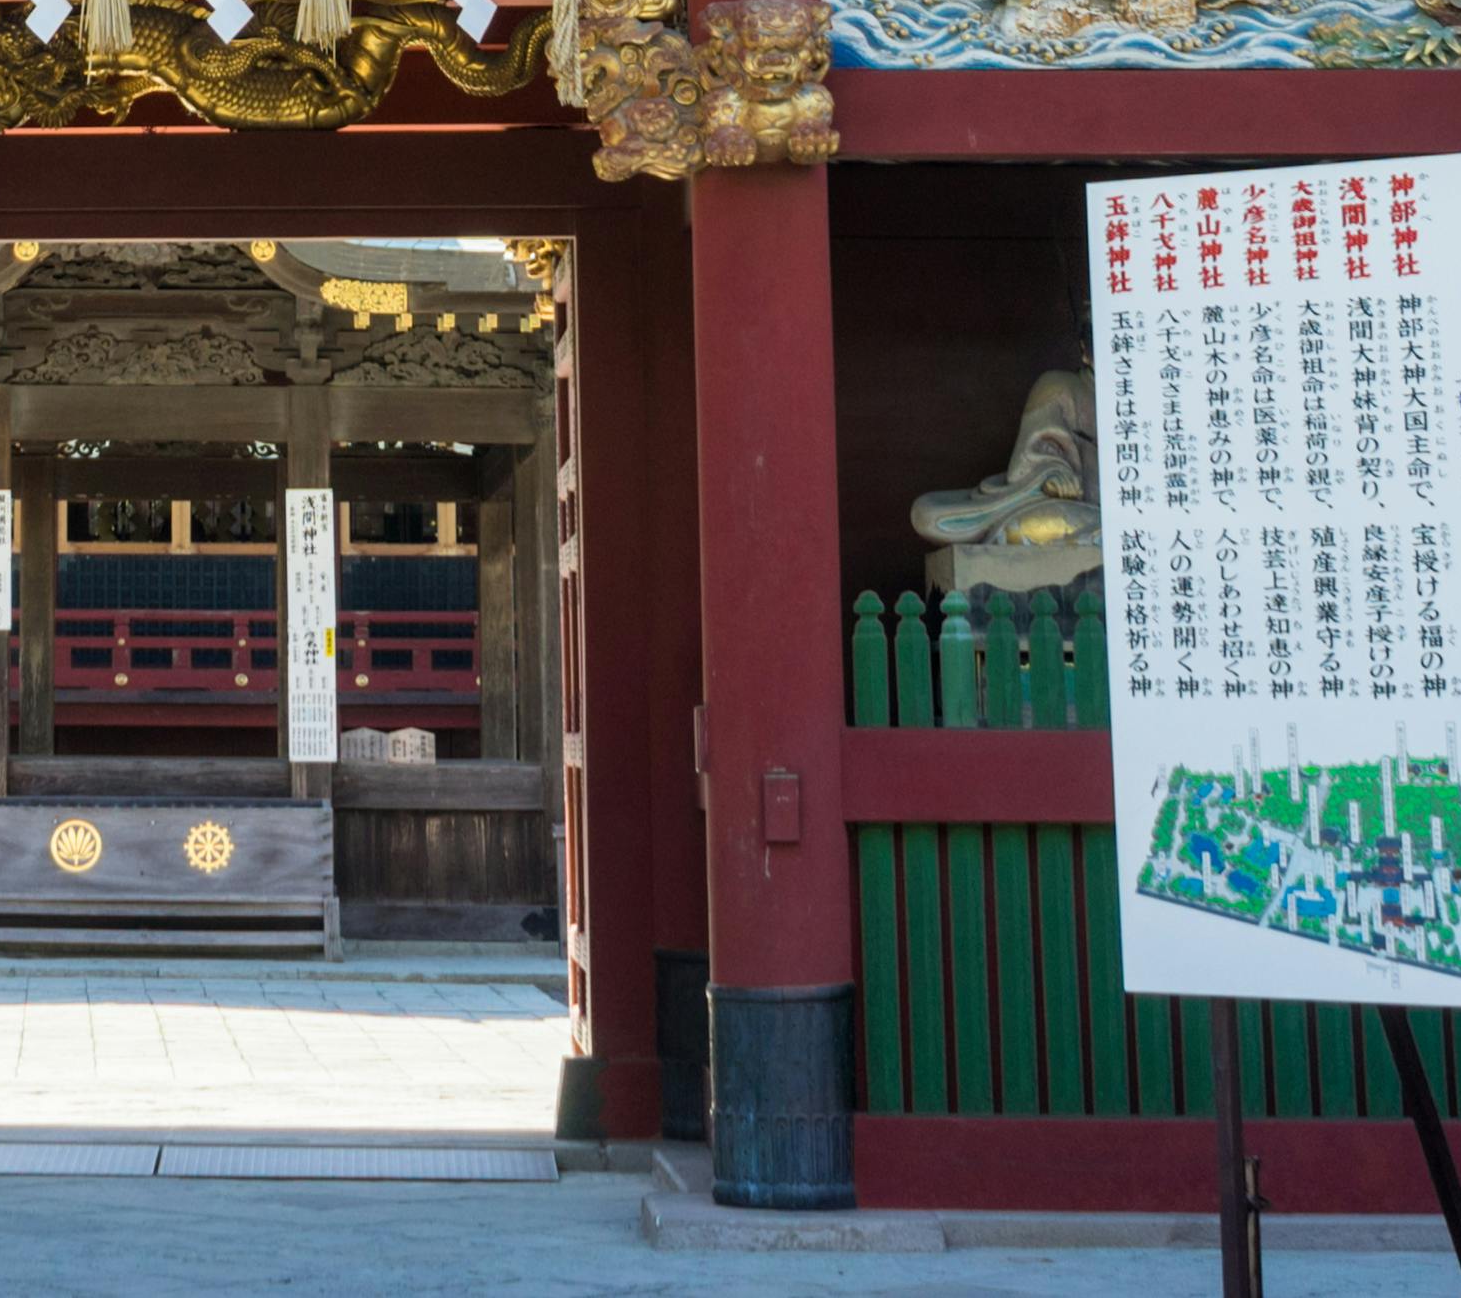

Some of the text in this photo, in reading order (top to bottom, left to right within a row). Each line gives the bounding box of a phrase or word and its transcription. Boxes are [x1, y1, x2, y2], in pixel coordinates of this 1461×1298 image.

[1105, 194, 1133, 295] 玉鉾神社
[1150, 192, 1179, 293] 八千戈神社
[1196, 186, 1225, 289] 麓山神社
[1241, 183, 1271, 287] 少彦名神社
[1291, 180, 1320, 282] 大歳御祖神社
[1339, 176, 1372, 281] 浅間神社
[1388, 172, 1421, 278] 神部神社
[1111, 310, 1152, 698] 玉鉾さまは学問の神、 試験合格祈る神
[1397, 293, 1446, 698] 神部大神大国主命で、 宝授ける福の神
[1215, 527, 1247, 699] 人のしあわせ招く神
[1260, 526, 1293, 699] 技芸上達知恵の神
[1310, 525, 1344, 699] 殖産興業守る神
[1361, 523, 1397, 700] 良縁安産子授けの神
